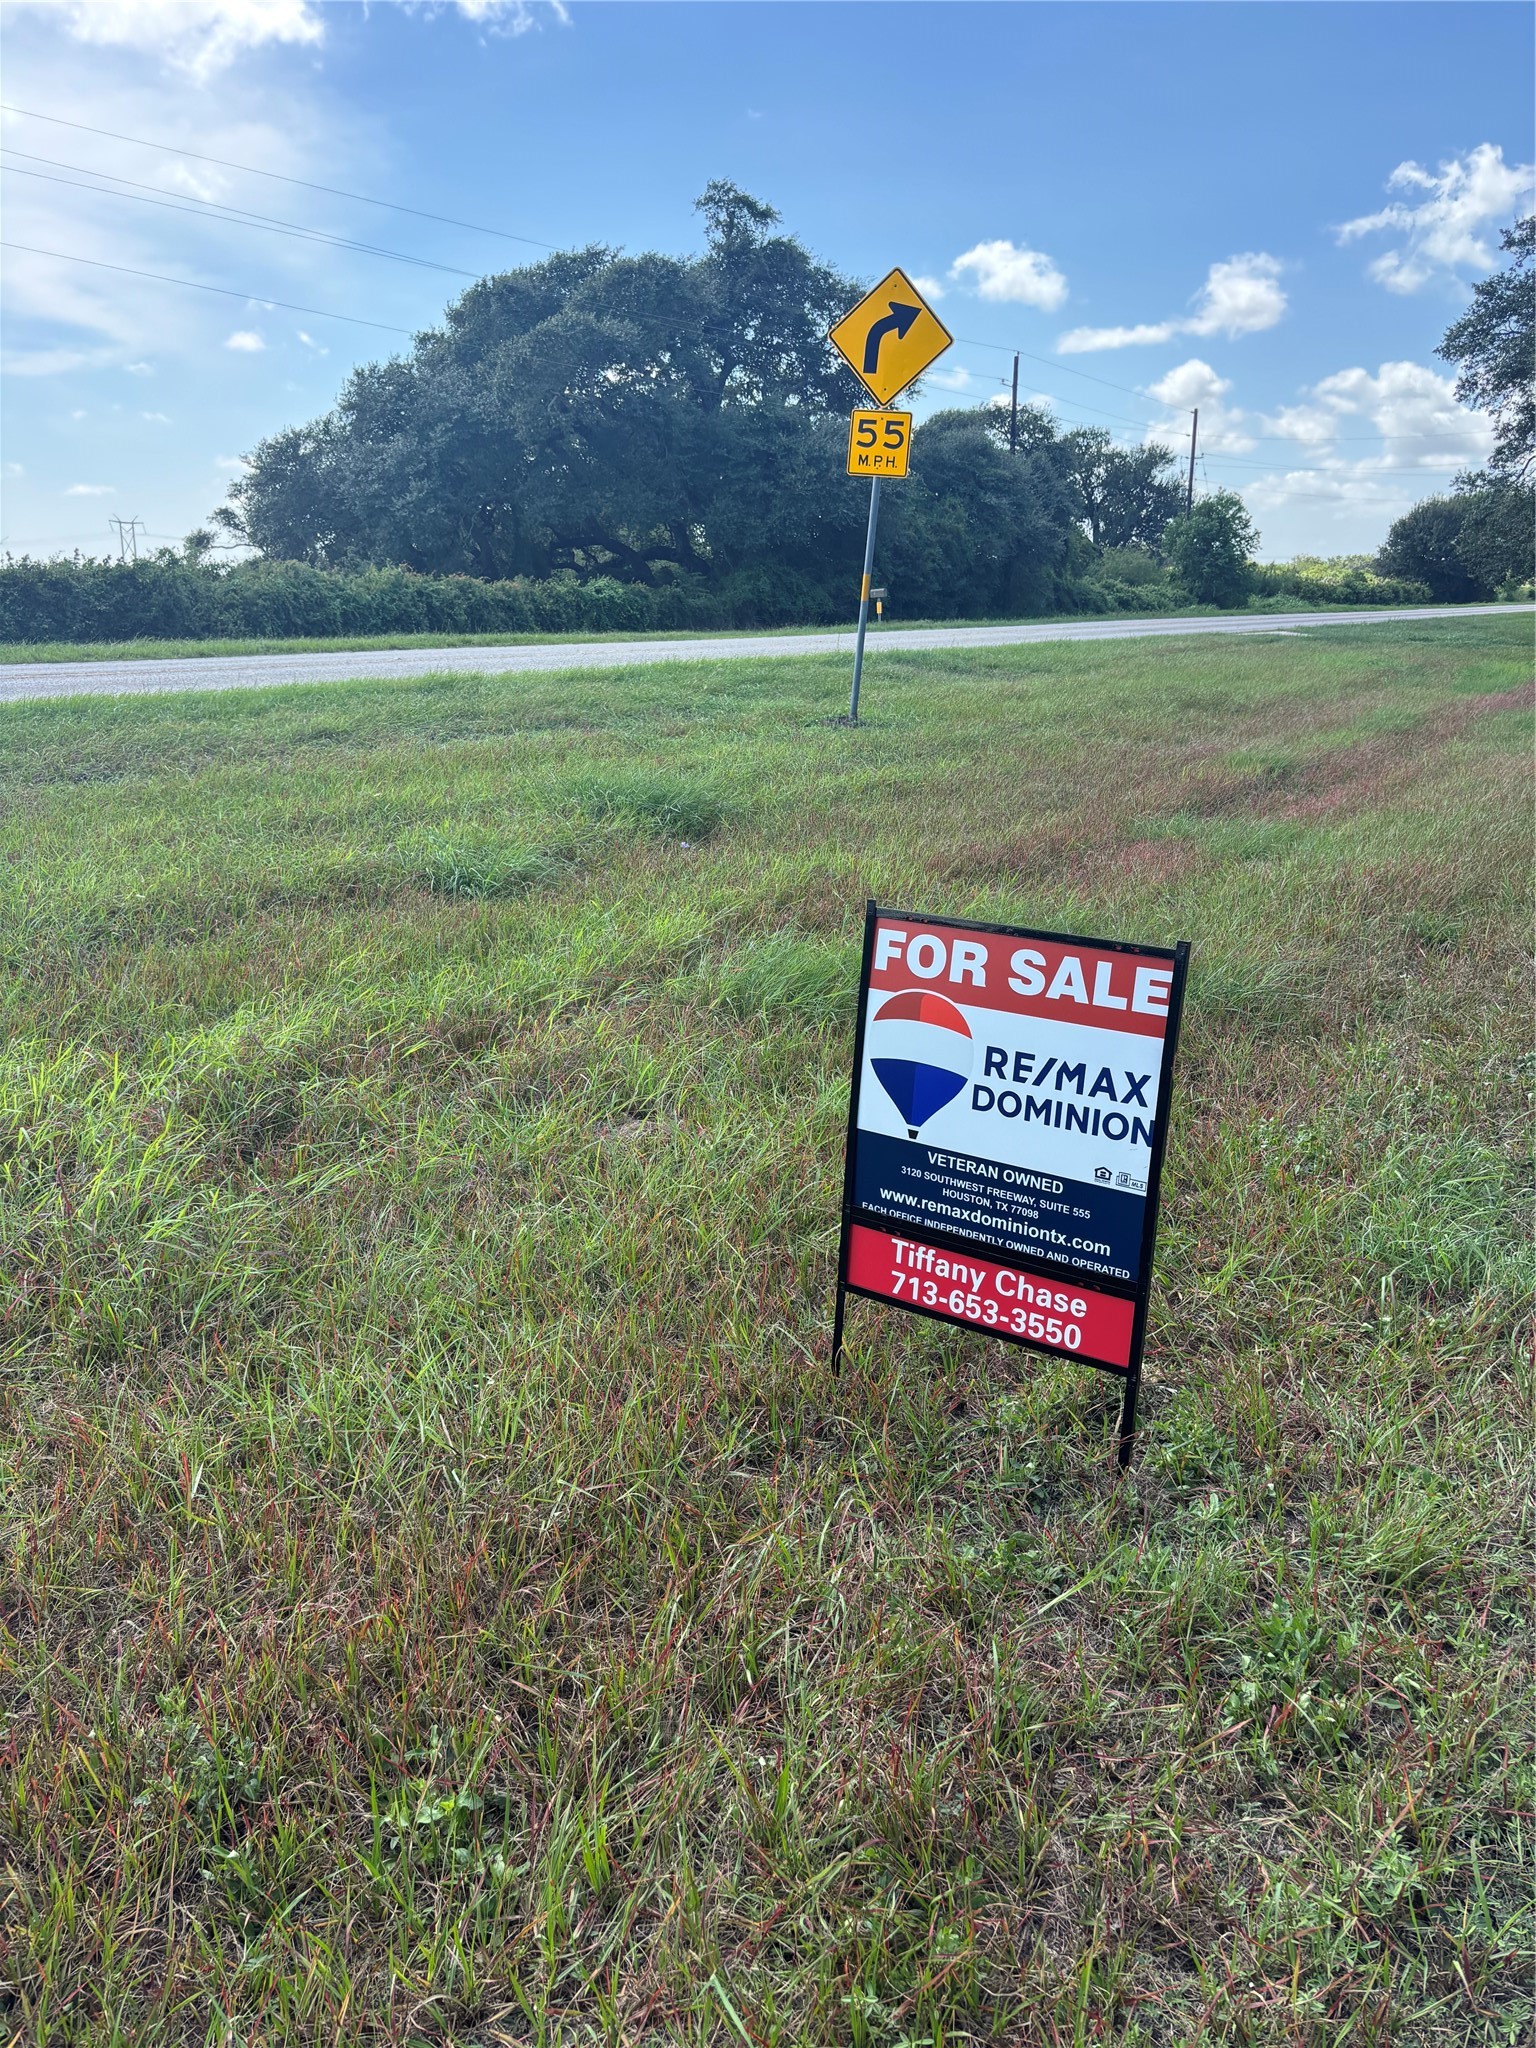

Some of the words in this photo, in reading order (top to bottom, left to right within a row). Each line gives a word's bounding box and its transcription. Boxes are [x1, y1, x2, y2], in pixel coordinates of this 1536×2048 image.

[856, 419, 904, 449] 55
[874, 928, 988, 988] FOR
[1008, 949, 1173, 1017] SALE
[984, 1046, 1152, 1108] RE/MAX
[971, 1084, 1155, 1148] DOMINION
[901, 1166, 922, 1178] 3120
[924, 1171, 984, 1193] SOUTHWEST
[987, 1186, 1037, 1207] FREEWAY,
[1039, 1199, 1070, 1214] SUITE
[1072, 1207, 1091, 1219] 555
[928, 1151, 999, 1179] VETERAN
[1003, 1169, 1063, 1194] OWNED
[942, 1188, 993, 1209] HOUSTON,
[995, 1200, 1008, 1212] TX
[1010, 1204, 1039, 1219] 77098
[862, 1201, 887, 1214] EACH
[889, 1209, 922, 1224] OFFICE
[924, 1219, 1004, 1246] INDEPENDENTLY
[1006, 1240, 1044, 1257] OWNED
[1046, 1251, 1069, 1264] AND
[1071, 1257, 1130, 1279] OPERATED
[880, 1187, 1111, 1256] www.remaxdominiontx.com
[891, 1238, 986, 1293] Tiffany
[995, 1270, 1087, 1318] Chase
[891, 1270, 1082, 1350] 713-653-3550
